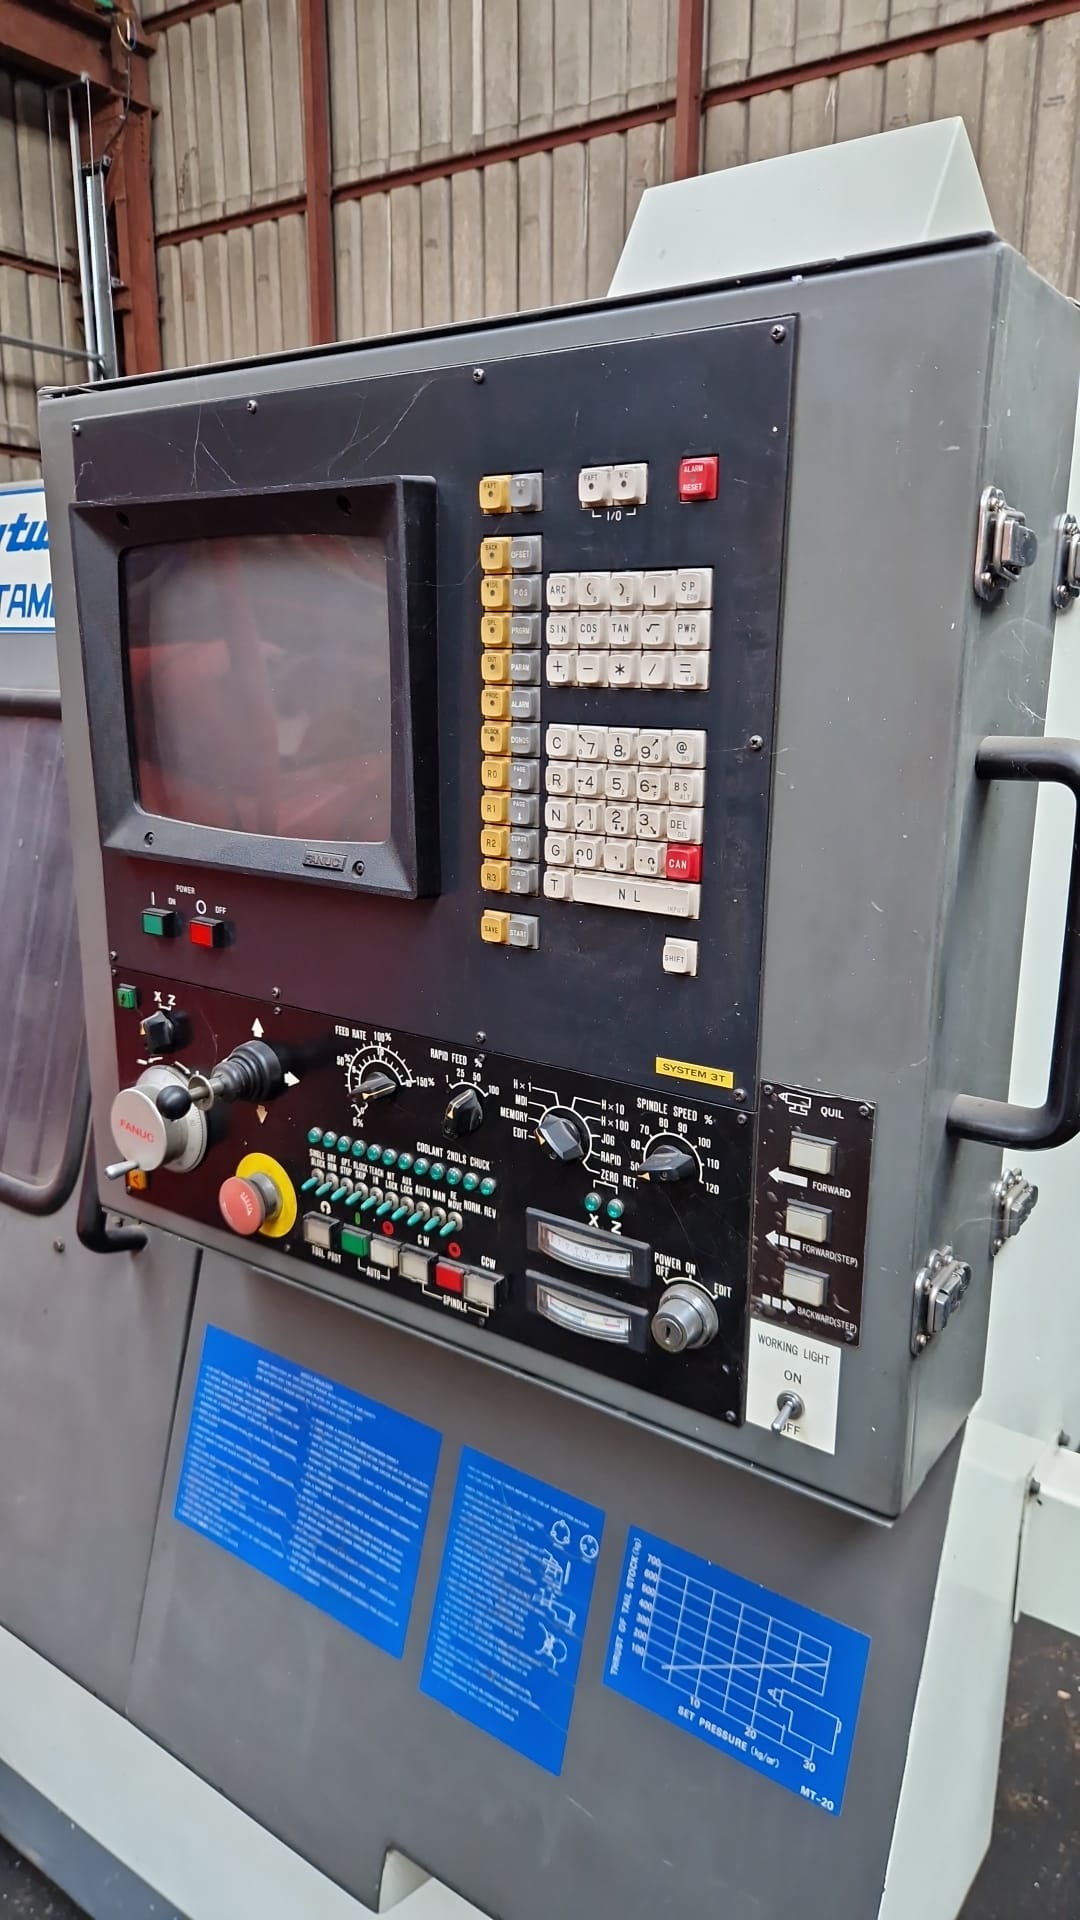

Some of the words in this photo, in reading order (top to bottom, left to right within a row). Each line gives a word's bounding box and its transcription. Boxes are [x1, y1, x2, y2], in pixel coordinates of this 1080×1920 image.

[684, 464, 703, 473] ALARM
[683, 483, 703, 492] RESET
[606, 510, 622, 521] I/O
[513, 589, 528, 597] POS
[550, 585, 567, 594] ARC
[580, 624, 597, 632] COS
[612, 624, 629, 633] TAN
[677, 624, 697, 632] PWR
[552, 737, 561, 749] C
[587, 742, 595, 755] 7
[676, 741, 688, 754] @
[613, 744, 623, 757] 8
[640, 745, 651, 759] 9
[552, 774, 561, 786] R
[585, 776, 594, 787] 4
[612, 778, 622, 790] 5
[640, 779, 650, 792] 6
[551, 809, 561, 821] N
[588, 808, 592, 821] 1
[611, 810, 621, 824] 2
[639, 813, 649, 826] 3
[670, 819, 688, 830] DEL
[486, 838, 497, 848] R2
[551, 844, 560, 856] G
[303, 856, 341, 868] FANUC
[668, 859, 687, 870] CAN
[486, 873, 497, 882] R3
[176, 884, 195, 895] POWER
[550, 879, 558, 891] T
[168, 897, 176, 905] ON
[215, 906, 227, 914] OFF
[484, 925, 499, 934] SAVE
[509, 929, 527, 938] START
[664, 954, 685, 964] SHIFT
[153, 991, 162, 1002] X
[168, 994, 176, 1005] Z
[335, 1025, 350, 1037] FEED
[352, 1028, 367, 1040] RATE
[373, 1031, 391, 1043] 100%
[336, 1053, 351, 1067] 50%
[430, 1048, 448, 1062] RAPID
[452, 1051, 467, 1066] FEED
[474, 1058, 483, 1068] %
[456, 1068, 465, 1078] 25
[472, 1072, 481, 1082] 50
[662, 1063, 707, 1079] SYSTEM
[710, 1072, 727, 1083] 3T
[416, 1076, 435, 1088] 150%
[488, 1085, 499, 1096] 100
[515, 1094, 528, 1106] MDI
[500, 1107, 528, 1122] MEMORY
[636, 1097, 668, 1115] SPINDLE
[673, 1106, 697, 1122] SPEED
[704, 1115, 713, 1125] %
[820, 1105, 845, 1120] QUIL
[353, 1117, 364, 1128] 0%
[659, 1117, 668, 1129] 80
[677, 1121, 688, 1134] 90
[120, 1118, 155, 1144] FANUC
[513, 1126, 528, 1139] EDIT
[640, 1124, 650, 1135] 70
[601, 1134, 615, 1146] JOG
[630, 1138, 641, 1150] 60
[698, 1136, 711, 1149] 100
[309, 1148, 325, 1160] SINGLE
[416, 1141, 444, 1159] COOLANT
[469, 1156, 490, 1171] CHUCK
[600, 1152, 621, 1166] RAPID
[310, 1157, 326, 1169] BLOCK
[353, 1160, 368, 1173] BLOCK
[707, 1157, 720, 1170] 110
[340, 1165, 353, 1176] STOP
[354, 1170, 367, 1180] SKIP
[369, 1165, 384, 1178] TEACH
[385, 1180, 398, 1191] LOCK
[600, 1169, 619, 1184] ZERO
[623, 1176, 639, 1190] RET.
[400, 1184, 414, 1195] LOCK
[415, 1184, 431, 1198] AUTO
[705, 1182, 720, 1195] 120
[812, 1181, 851, 1199] FORWARD
[432, 1189, 446, 1202] MAN
[447, 1199, 462, 1211] MOVE
[483, 1206, 496, 1219] REV
[588, 1213, 599, 1228] X
[611, 1220, 622, 1235] Z
[312, 1245, 325, 1259] TOOL
[327, 1250, 342, 1264] POST
[481, 1255, 496, 1270] CCW
[654, 1252, 681, 1269] POWER
[685, 1261, 696, 1276] ON
[366, 1266, 381, 1281] AUTO
[656, 1264, 669, 1278] OFF
[714, 1283, 733, 1299] EDIT
[442, 1294, 468, 1314] SPINDLE
[758, 1333, 798, 1356] WORKING
[803, 1346, 830, 1366] LIGHT
[784, 1369, 803, 1385] ON
[647, 1553, 661, 1567] 700
[626, 1554, 639, 1590] STOCK
[621, 1593, 632, 1614] TAIL
[618, 1616, 627, 1633] OF
[633, 1626, 648, 1642] 200
[609, 1634, 624, 1676] THRUST
[631, 1642, 646, 1657] 100
[690, 1695, 701, 1709] 10
[677, 1705, 695, 1721] SET
[699, 1716, 748, 1752] PRESSURE
[744, 1726, 757, 1740] 20
[803, 1759, 816, 1773] 30
[800, 1784, 835, 1811] MT-20
